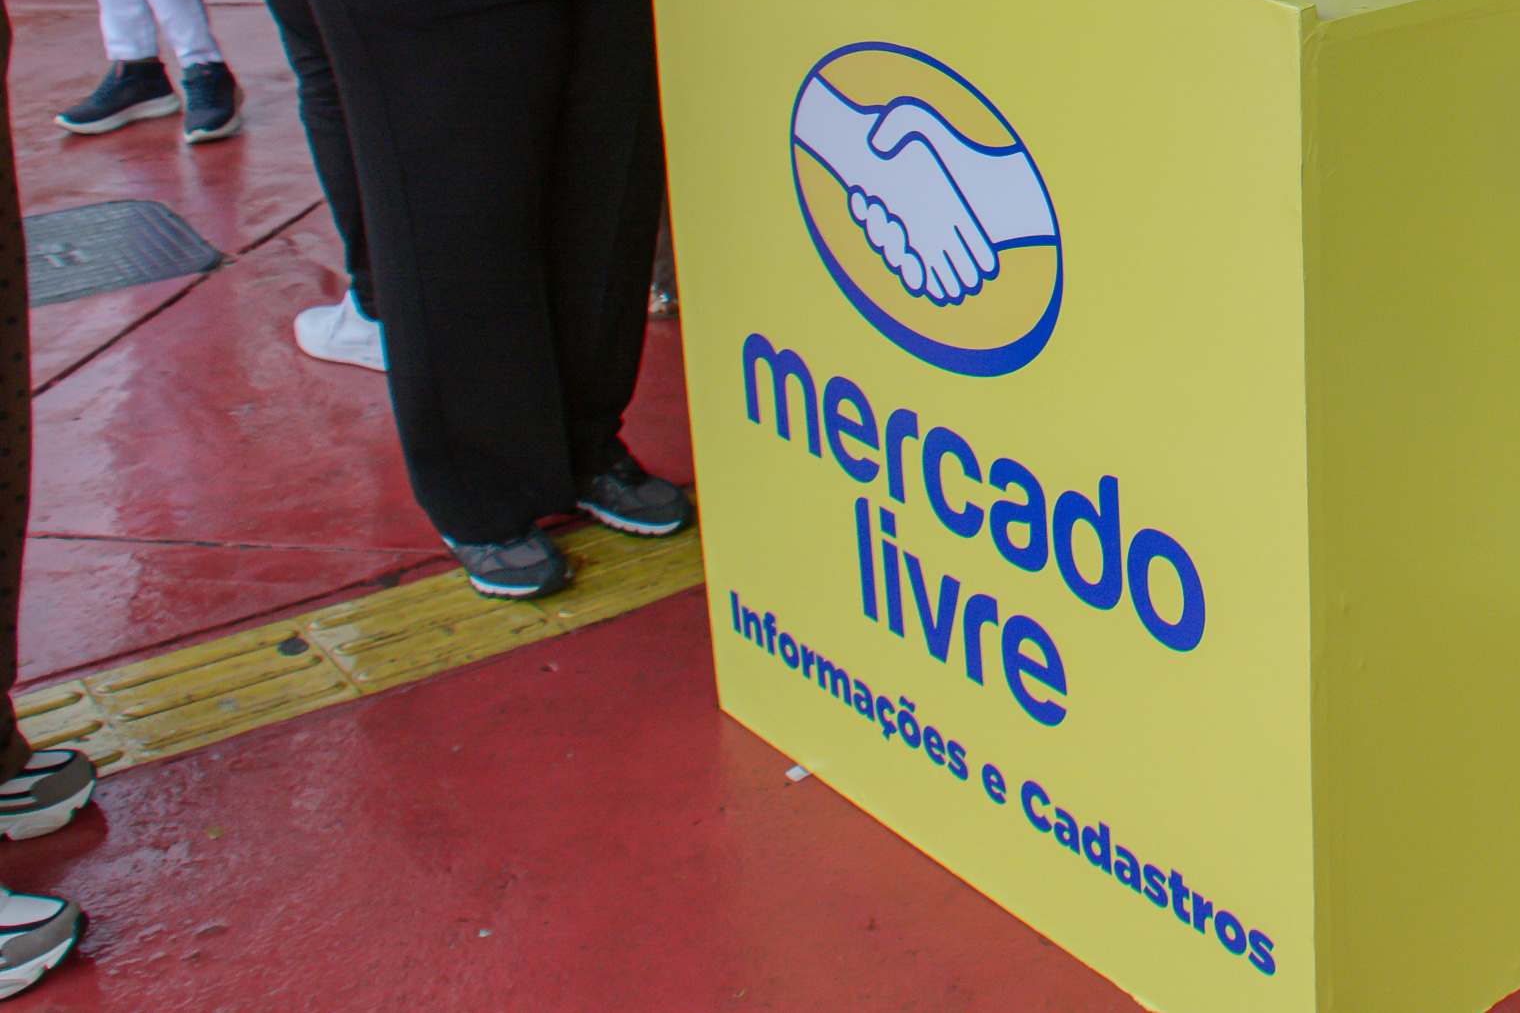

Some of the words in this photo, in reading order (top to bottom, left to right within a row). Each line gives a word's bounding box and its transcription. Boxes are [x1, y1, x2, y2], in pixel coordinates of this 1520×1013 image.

[743, 332, 1207, 652] mercado
[856, 497, 1067, 727] livre
[730, 590, 969, 781] Informações
[982, 763, 1007, 804] e
[1021, 780, 1277, 976] Cadastros
